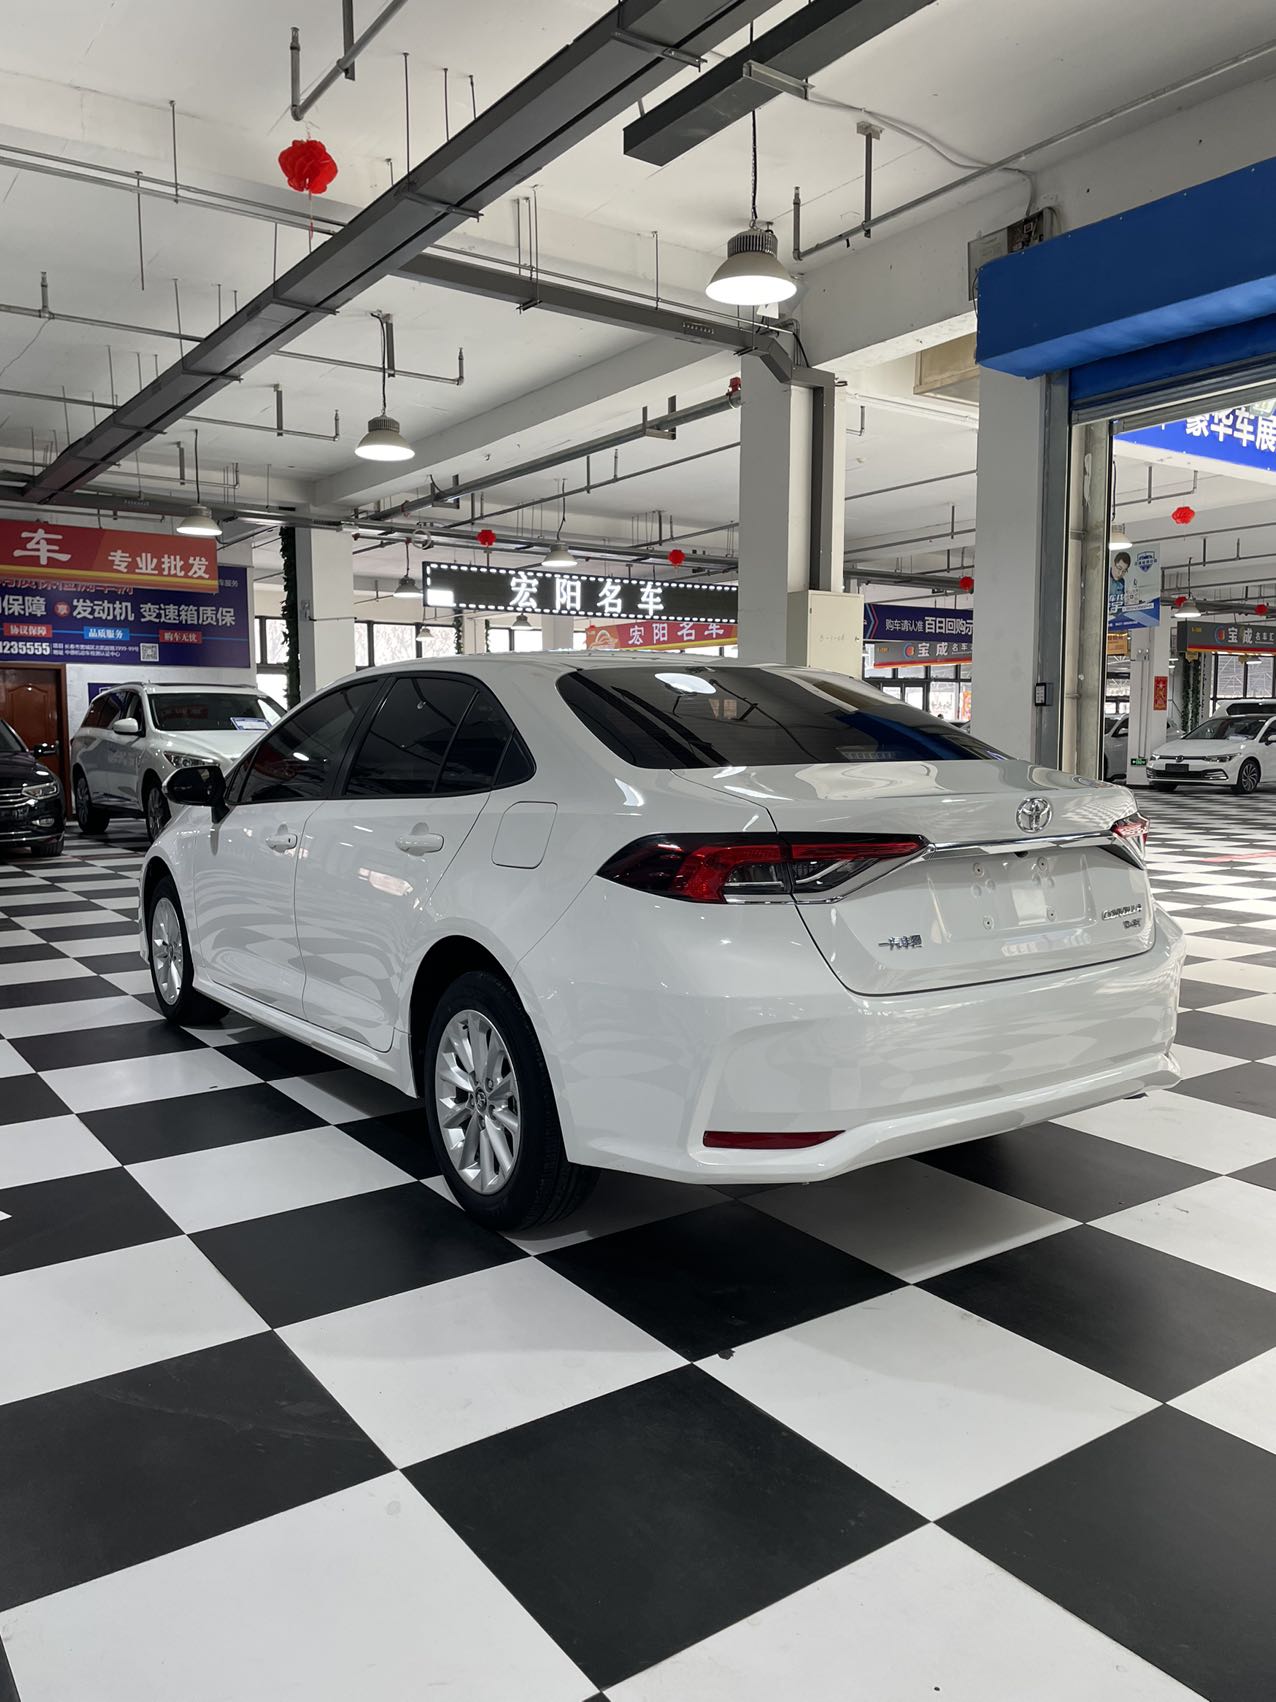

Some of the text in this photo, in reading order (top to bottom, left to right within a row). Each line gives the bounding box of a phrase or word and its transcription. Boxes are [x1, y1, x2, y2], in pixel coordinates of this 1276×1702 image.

[13, 528, 210, 578] 车 专业批发
[509, 572, 664, 617] 宏阳名车
[0, 594, 47, 617] 保障
[73, 598, 135, 621] 发动机
[140, 603, 236, 627] 变速箱质保
[628, 623, 724, 645] 宏阳名车
[1227, 627, 1253, 644] 宝成
[917, 642, 949, 657] 宝成
